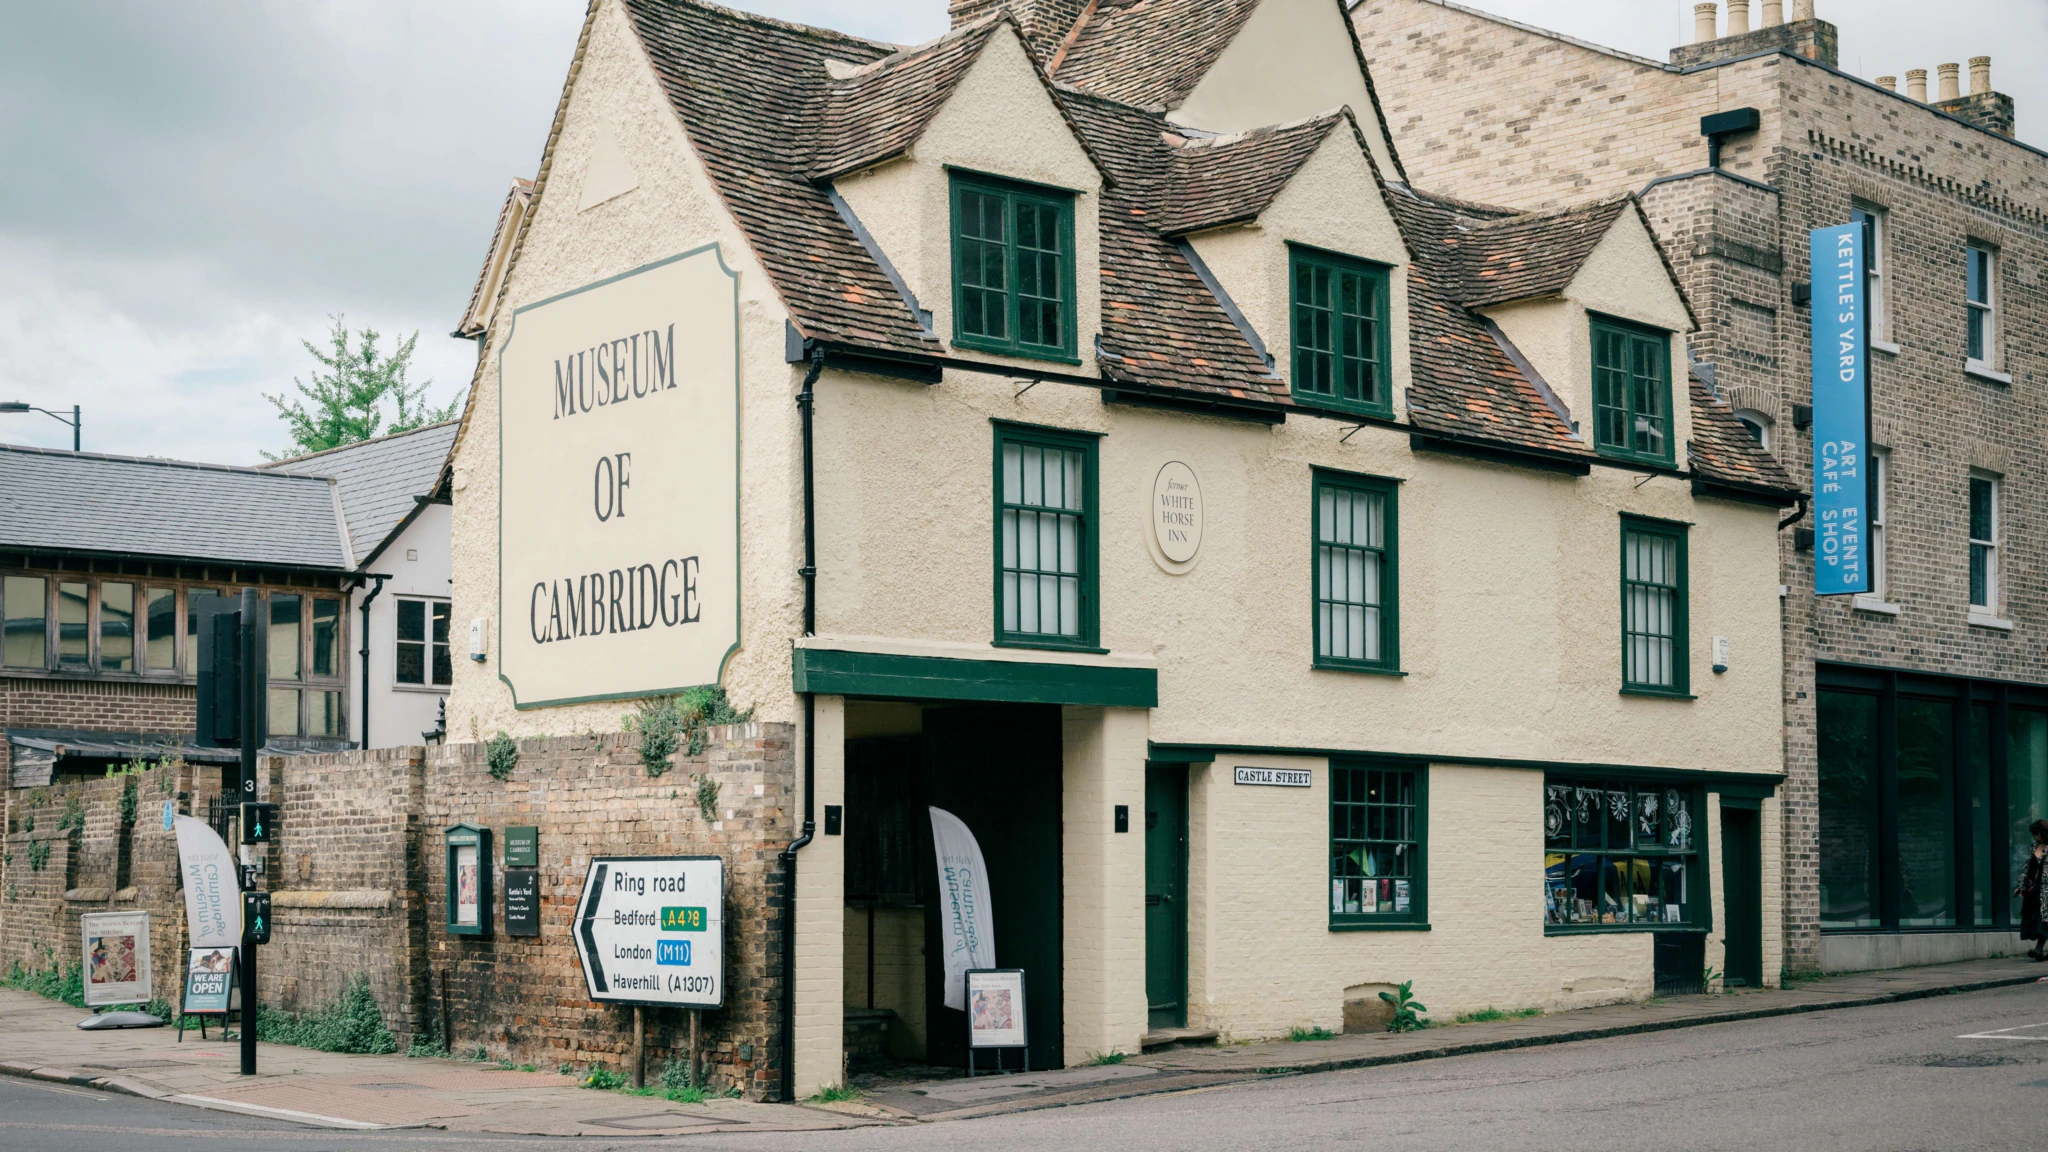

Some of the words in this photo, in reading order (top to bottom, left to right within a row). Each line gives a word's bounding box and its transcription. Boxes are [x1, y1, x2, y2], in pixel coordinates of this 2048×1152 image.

[1838, 233, 1854, 324] KETTLE'S
[1839, 328, 1854, 382] YARD
[553, 322, 677, 420] MUSEUM
[1822, 441, 1841, 493] CAFÉ
[1841, 440, 1856, 478] ART
[594, 452, 631, 523] OF
[1166, 478, 1188, 492] former
[1161, 494, 1194, 510] WHITE
[1162, 511, 1194, 526] HORSE
[1168, 529, 1187, 542] INN
[1822, 509, 1838, 567] SHOP
[1842, 507, 1858, 584] EVENTS
[530, 555, 701, 645] CAMBRIDGE
[244, 779, 254, 792] 3
[1238, 770, 1272, 782] CASTLE
[1275, 772, 1310, 784] STREET
[614, 872, 645, 895] Ring
[653, 872, 685, 892] road
[614, 910, 656, 926] Bedford
[614, 943, 652, 960] London
[658, 942, 689, 962] (M11)
[192, 982, 223, 994] OPEN
[194, 973, 207, 982] WE
[208, 973, 224, 982] ARE
[613, 973, 660, 990] Haverhill
[668, 974, 715, 995] (A1307)
